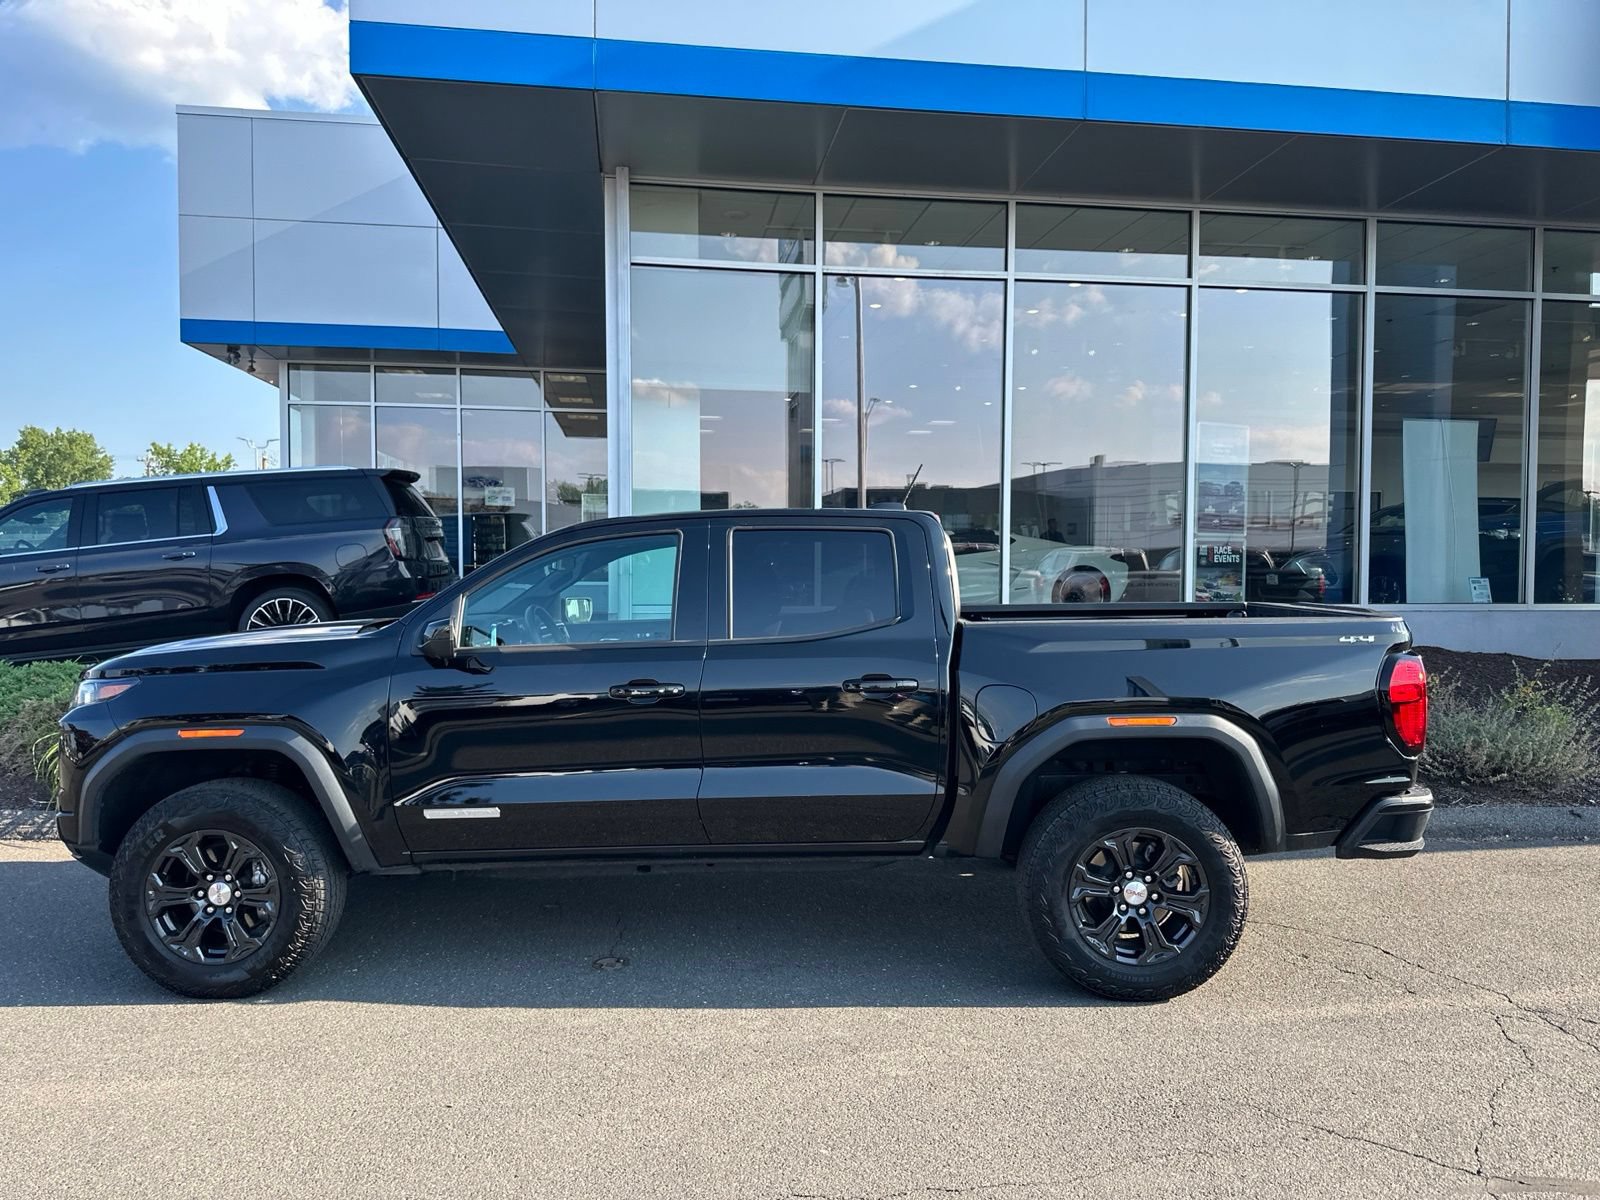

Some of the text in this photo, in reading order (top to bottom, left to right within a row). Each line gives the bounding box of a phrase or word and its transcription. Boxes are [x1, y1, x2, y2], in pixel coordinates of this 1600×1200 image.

[1213, 546, 1232, 555] RACE
[1213, 555, 1240, 563] EVENTS
[1126, 888, 1144, 897] GMC
